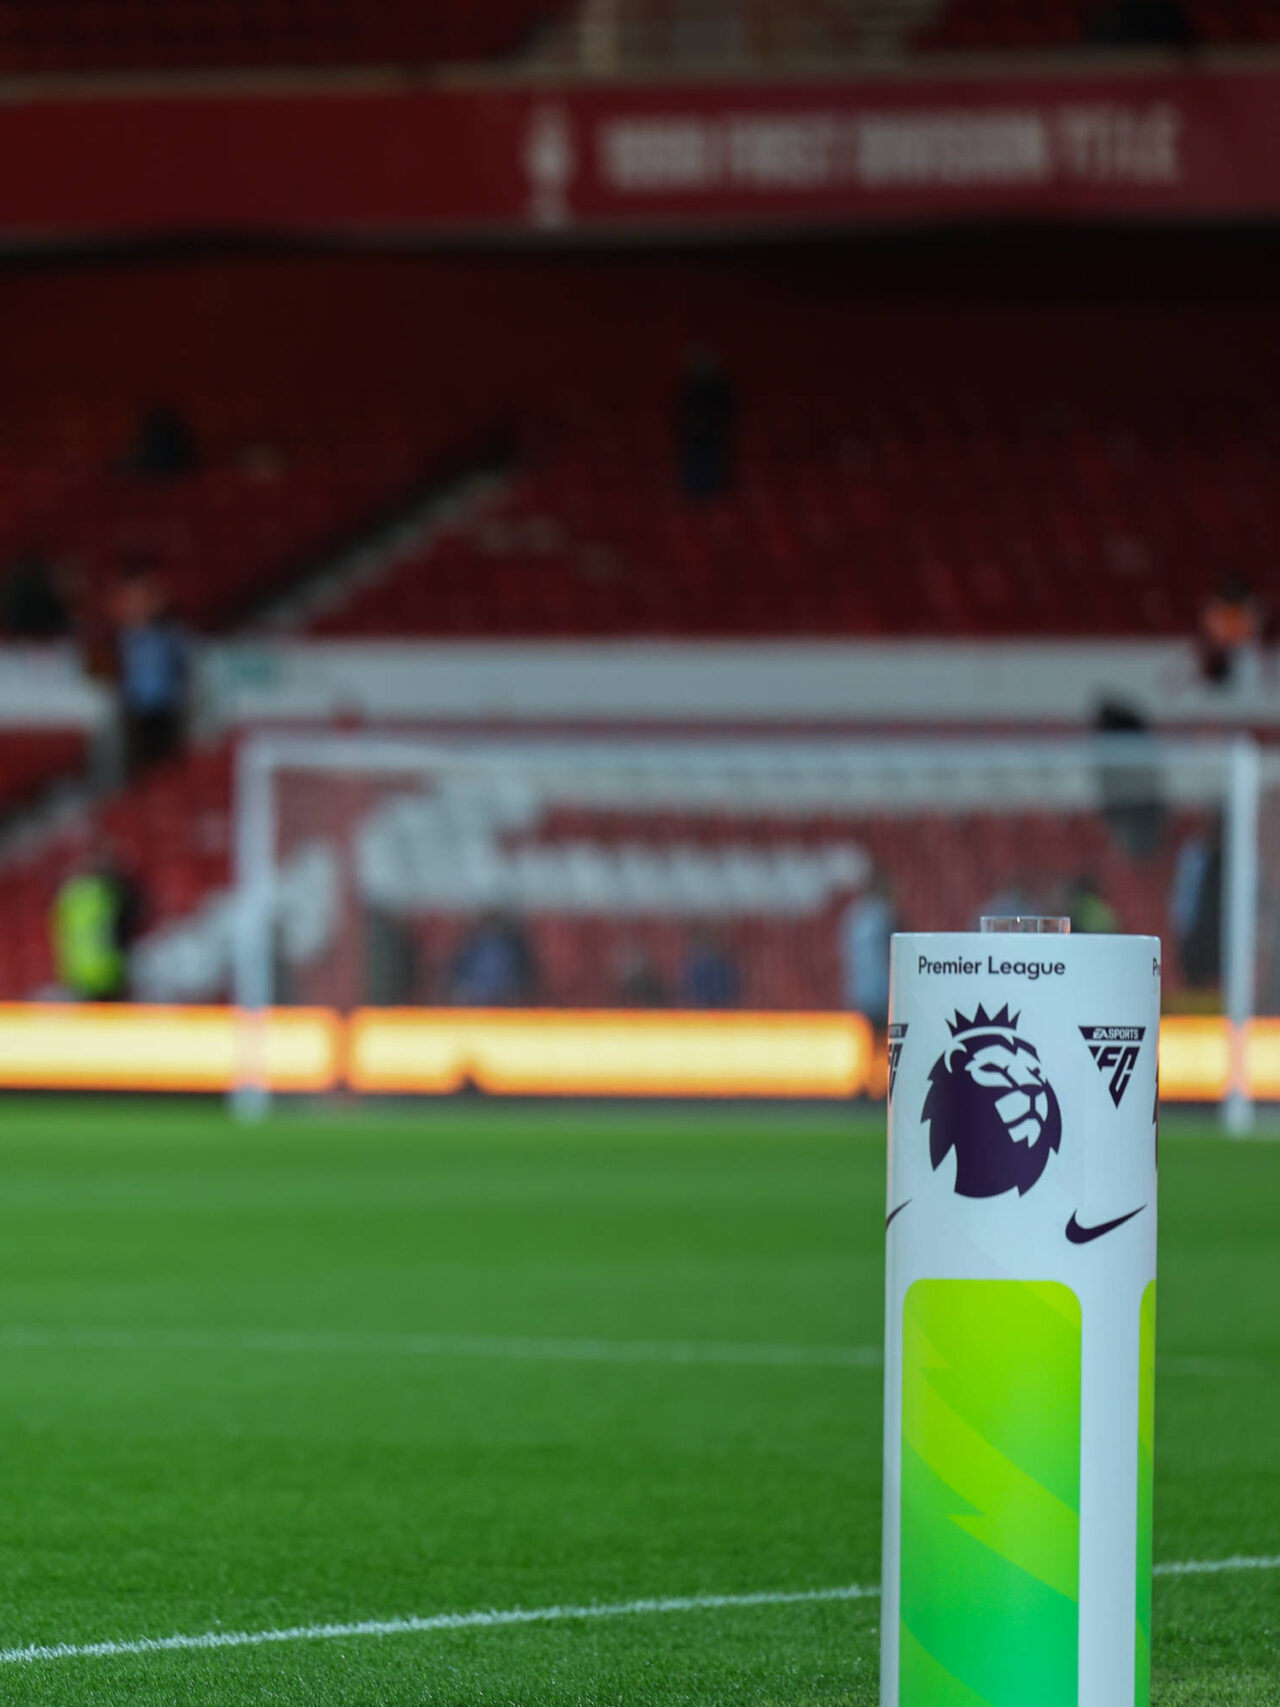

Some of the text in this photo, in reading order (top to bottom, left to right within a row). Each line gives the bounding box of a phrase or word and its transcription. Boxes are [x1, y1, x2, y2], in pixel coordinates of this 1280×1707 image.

[918, 955, 1066, 981] Premier League
[1096, 1045, 1141, 1110] FC
